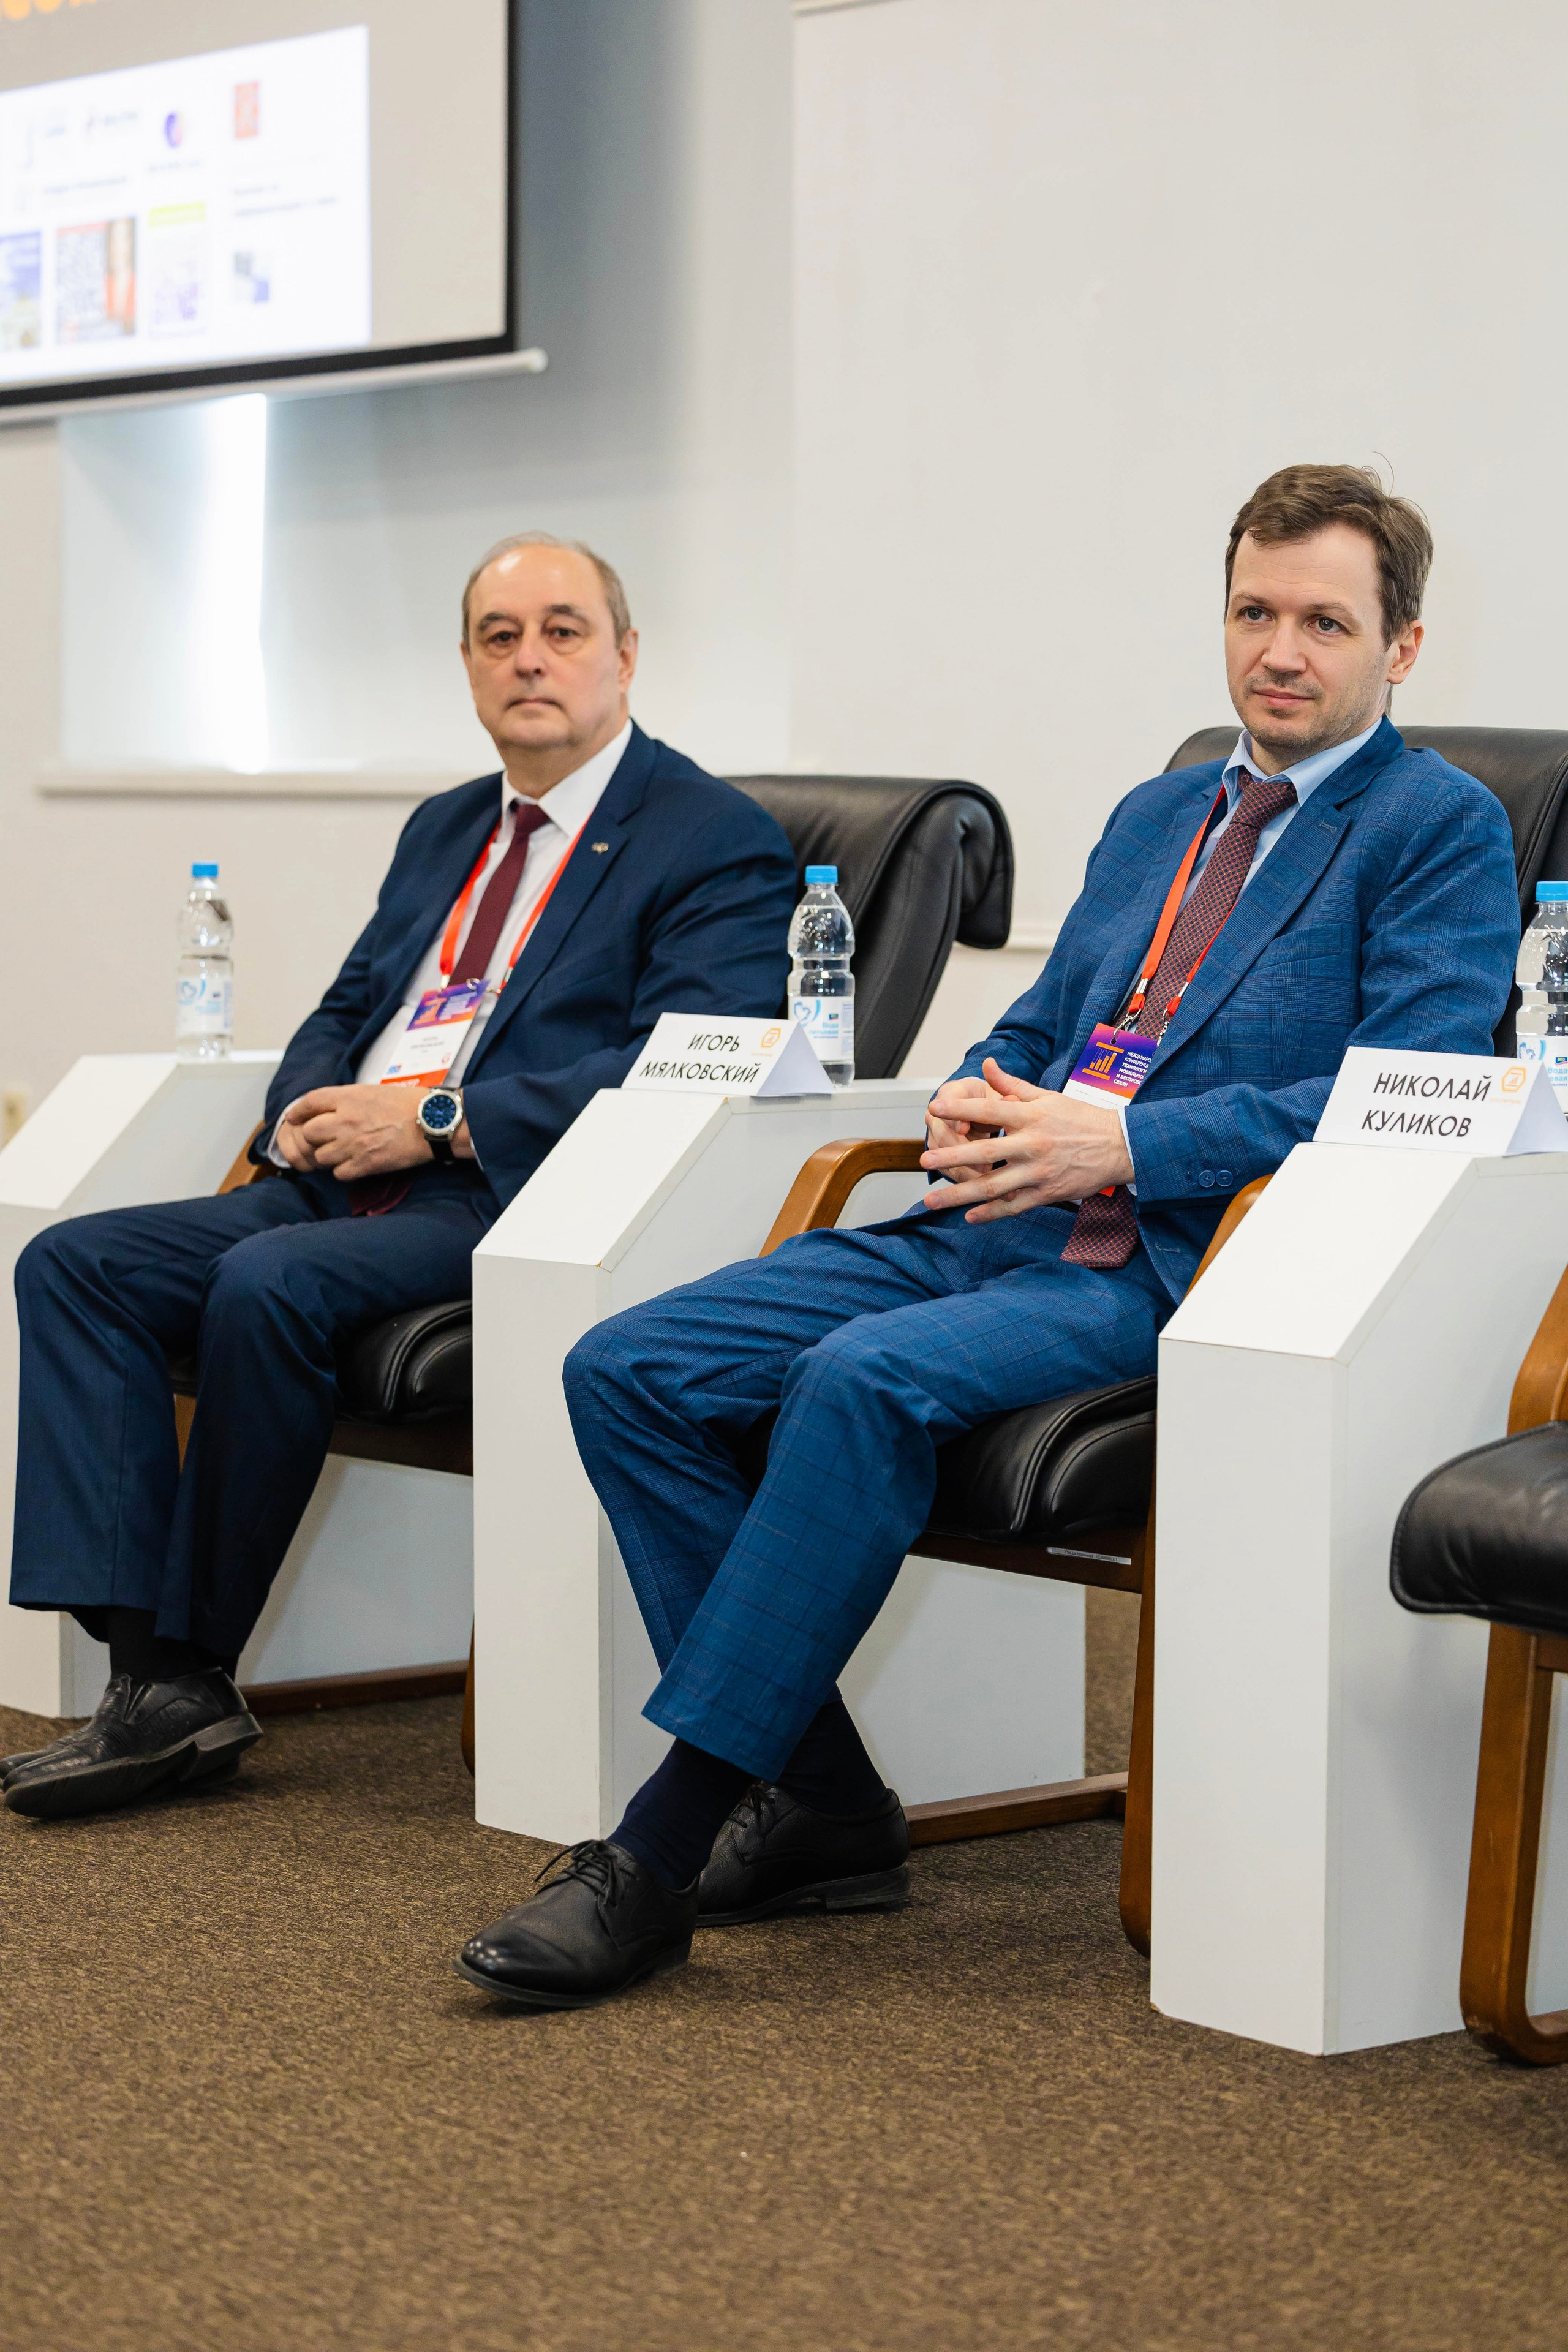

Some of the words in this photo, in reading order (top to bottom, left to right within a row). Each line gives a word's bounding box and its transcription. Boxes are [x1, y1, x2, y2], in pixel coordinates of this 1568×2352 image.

[687, 1034, 740, 1052] ИГОРЬ
[1127, 1051, 1152, 1063] МЕЖДУНАРО
[639, 1061, 761, 1083] МЯЛКОВСКИЙ
[1114, 1079, 1128, 1087] СВЯЗИ
[1373, 1072, 1492, 1101] НИКОЛАЙ
[1361, 1110, 1471, 1137] КУЛИКОВ
